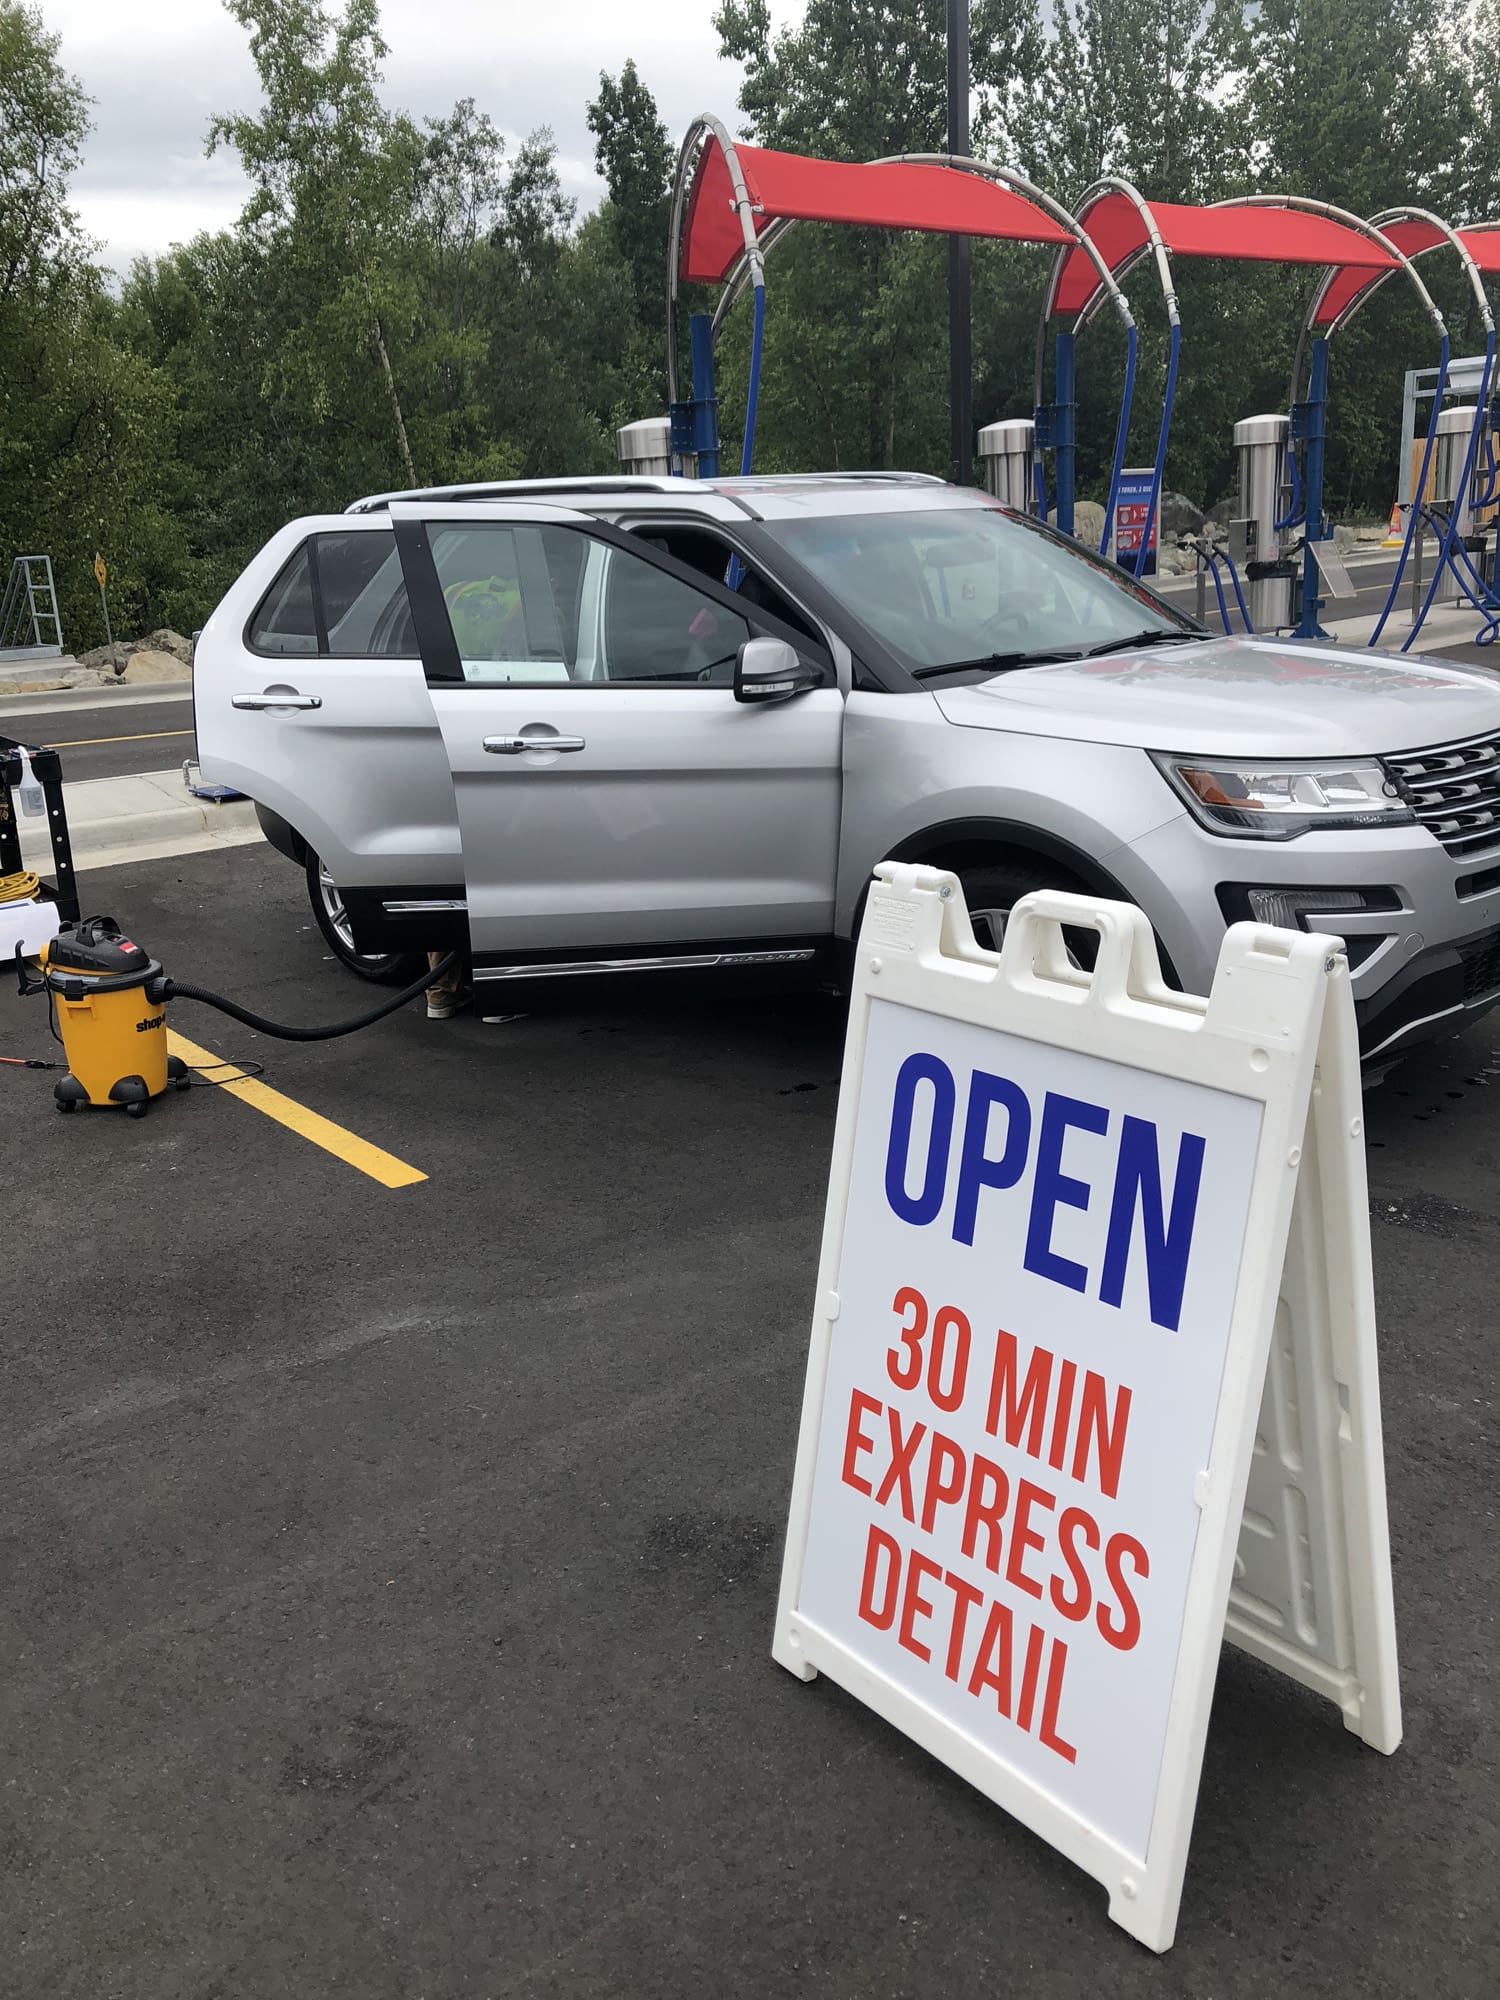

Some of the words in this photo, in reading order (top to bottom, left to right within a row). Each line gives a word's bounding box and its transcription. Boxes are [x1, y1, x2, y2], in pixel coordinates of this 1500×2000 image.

[885, 1052, 1206, 1332] OPEN
[886, 1286, 971, 1413] 30
[985, 1329, 1132, 1499] MIN
[841, 1388, 1149, 1651] EXPRESS
[858, 1523, 1076, 1764] DETAIL
